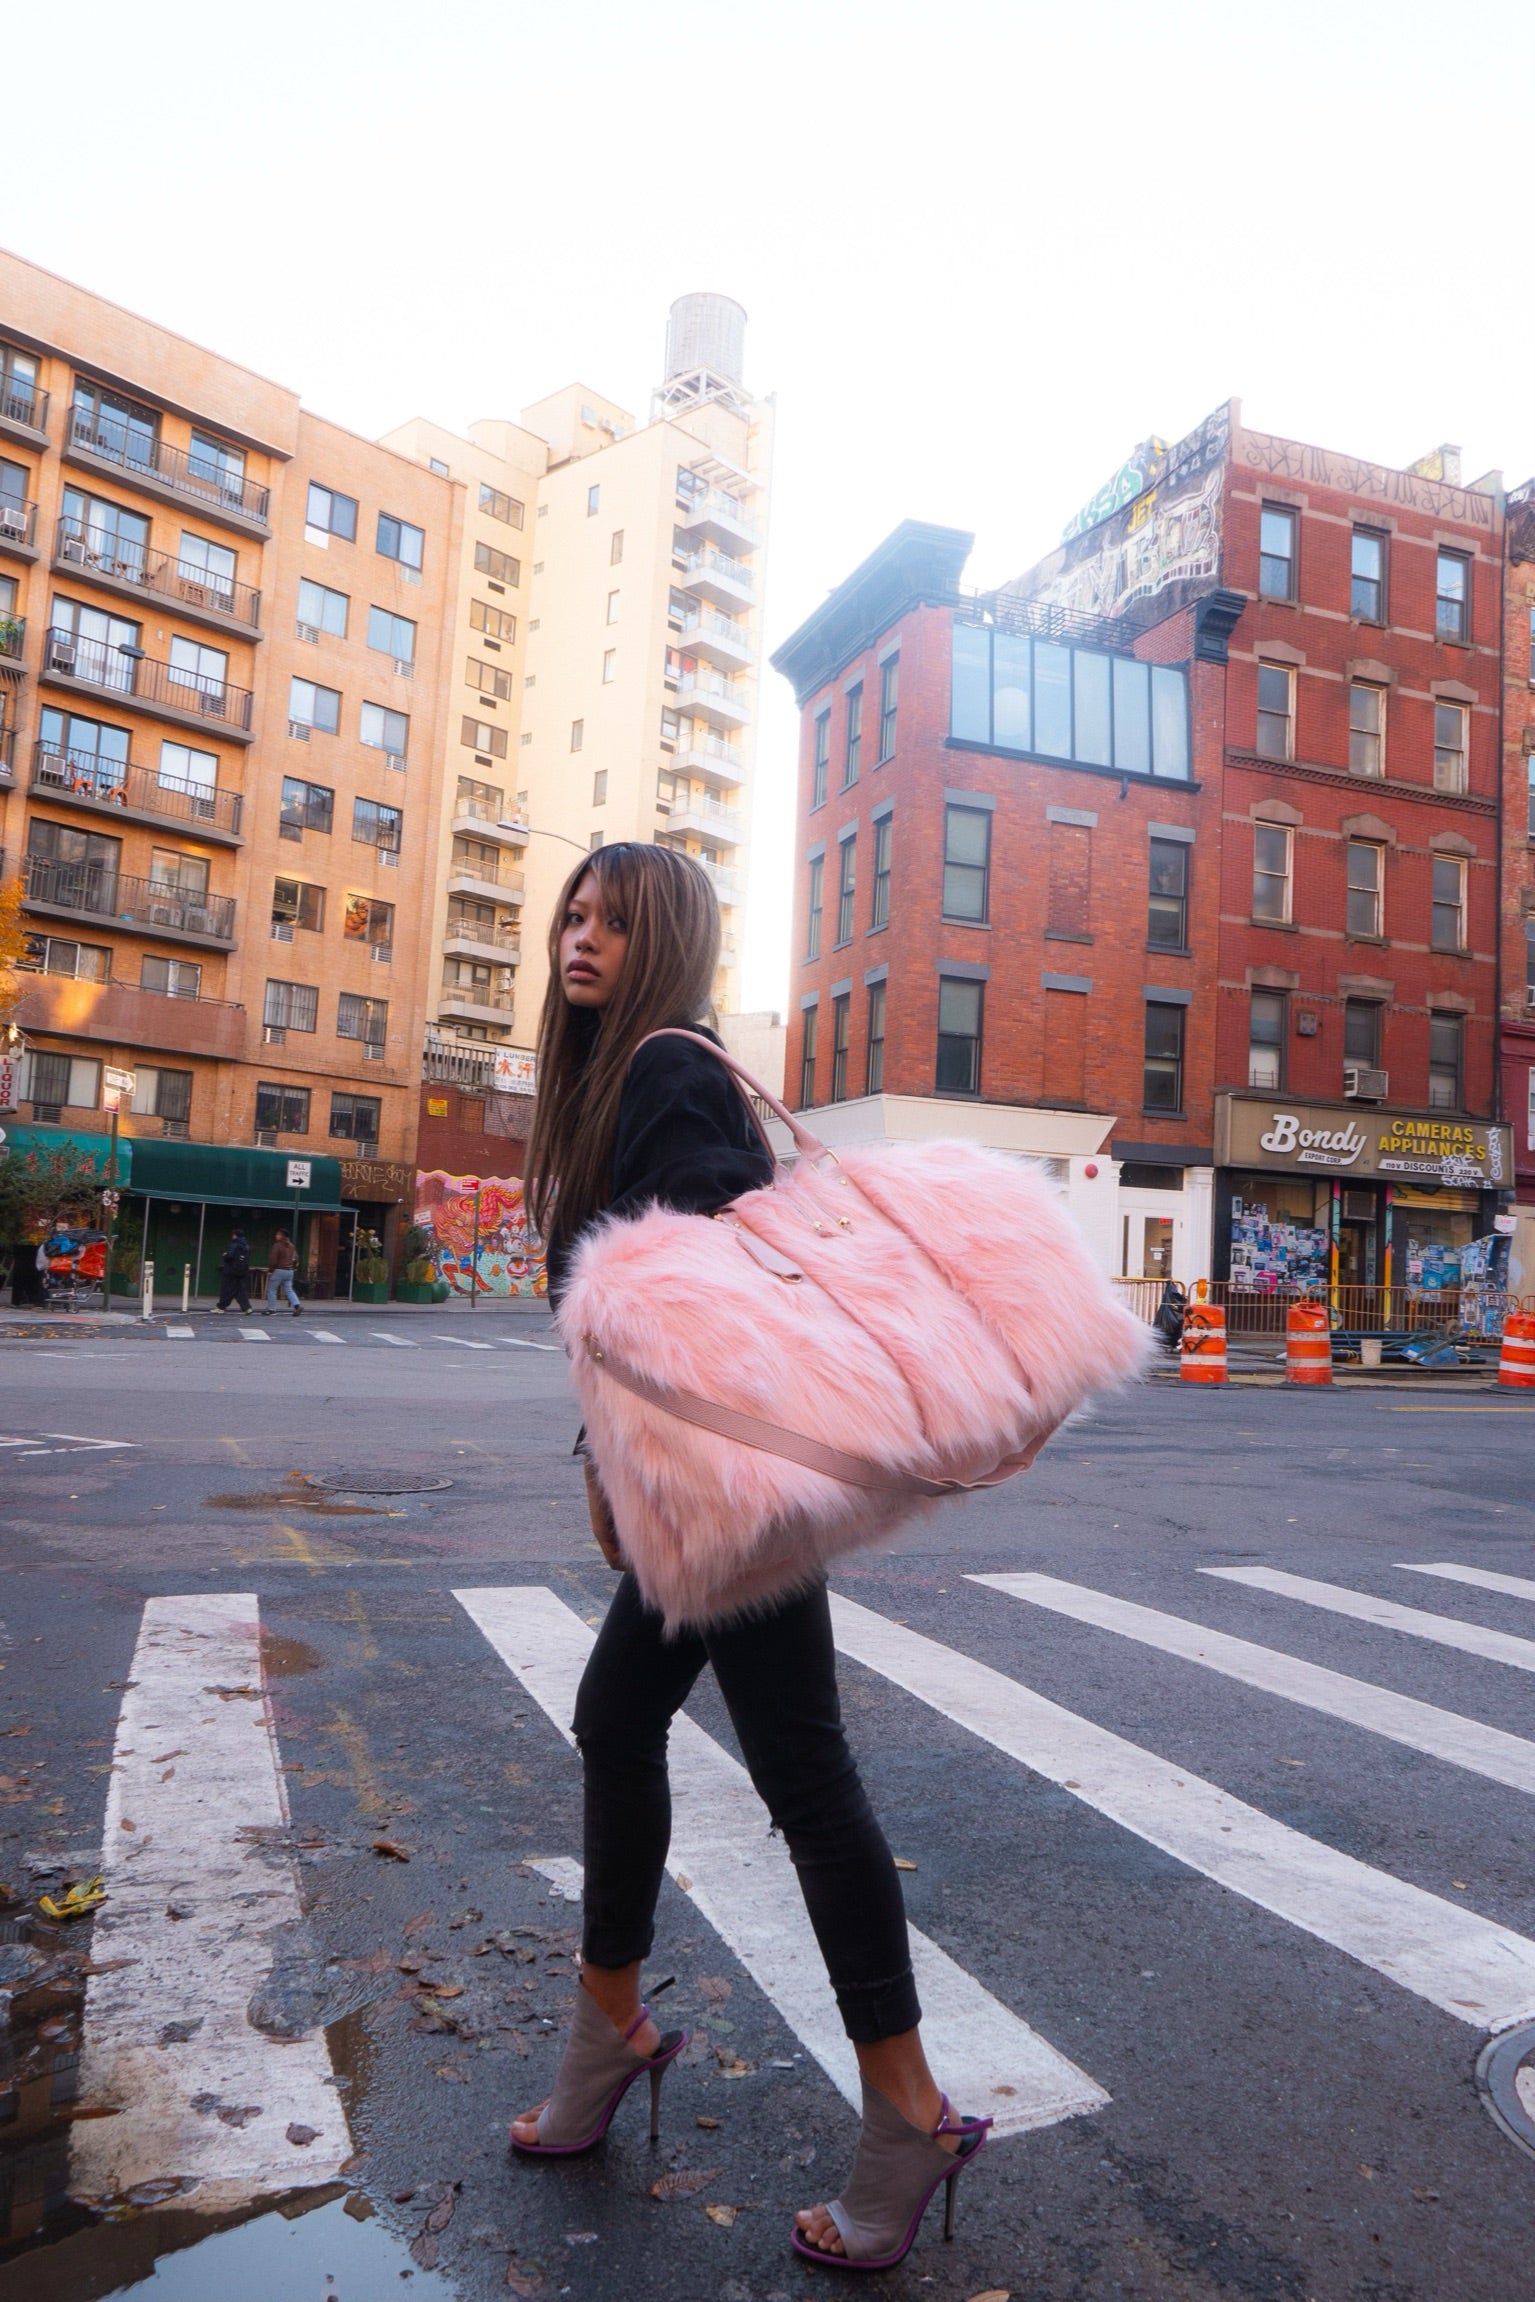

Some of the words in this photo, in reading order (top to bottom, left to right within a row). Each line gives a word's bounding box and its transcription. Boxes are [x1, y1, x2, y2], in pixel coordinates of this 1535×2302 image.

[1127, 491, 1157, 534] JET
[0, 1058, 13, 1106] LIQUOR
[1260, 1113, 1368, 1165] Bondy
[1391, 1119, 1474, 1144] CAMERAS
[1304, 1151, 1326, 1161] EXPORT
[1378, 1135, 1487, 1160] APPLIANCES
[1403, 1161, 1455, 1175] DISCOUNTS
